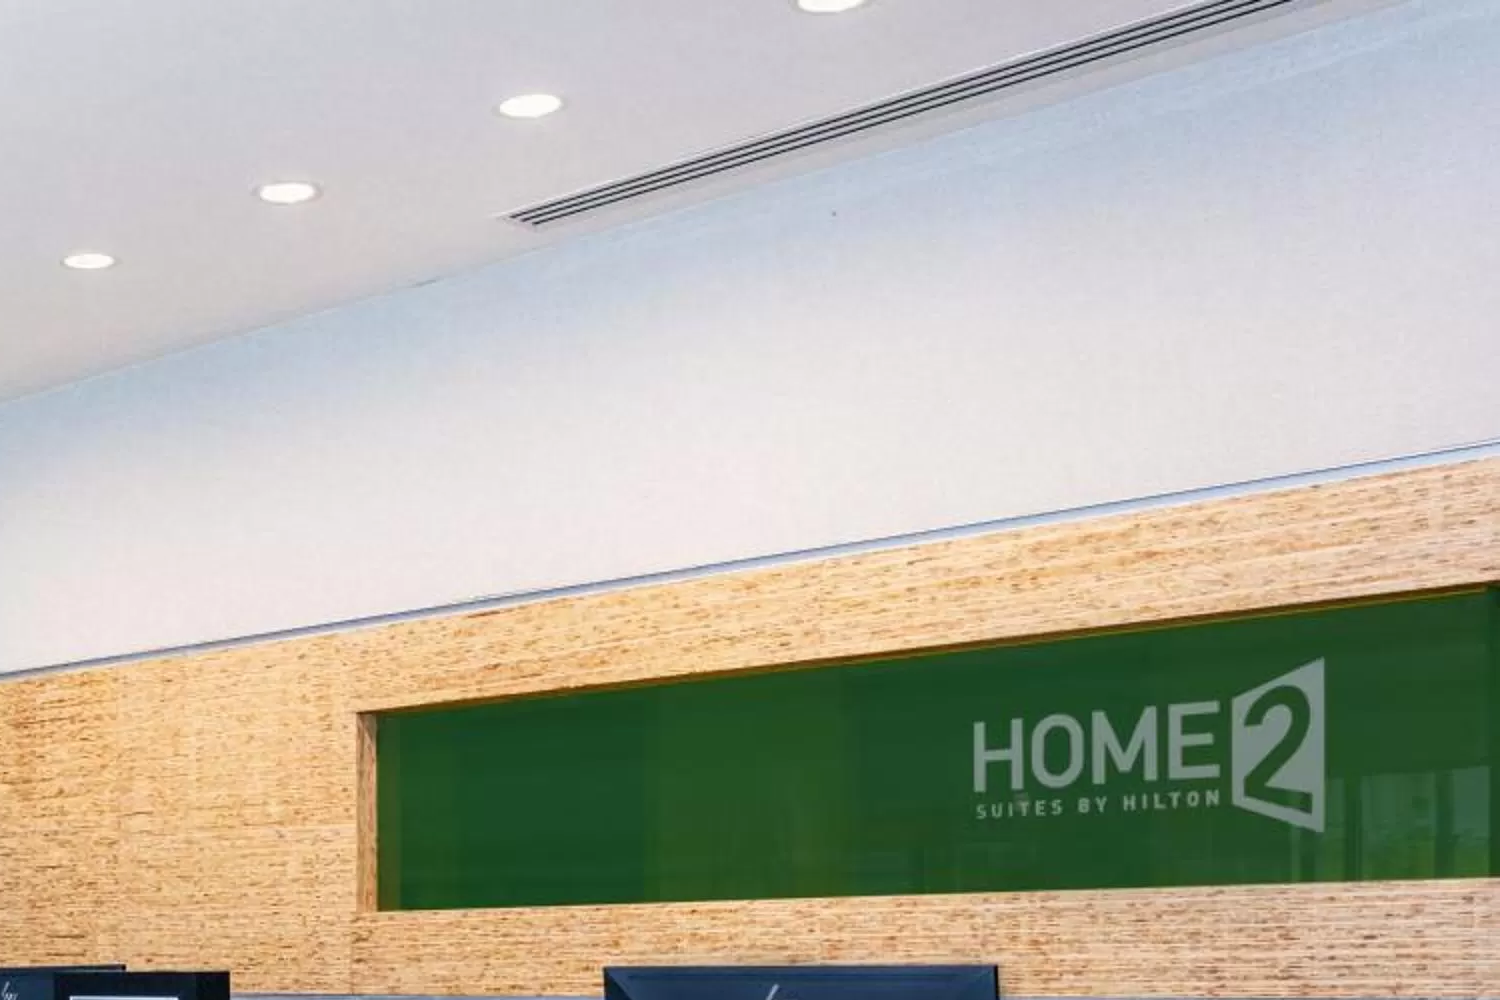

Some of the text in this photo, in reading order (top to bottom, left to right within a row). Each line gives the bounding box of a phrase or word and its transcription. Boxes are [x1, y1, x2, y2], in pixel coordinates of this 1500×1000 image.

[975, 789, 1221, 820] SUITES BY HILTON
